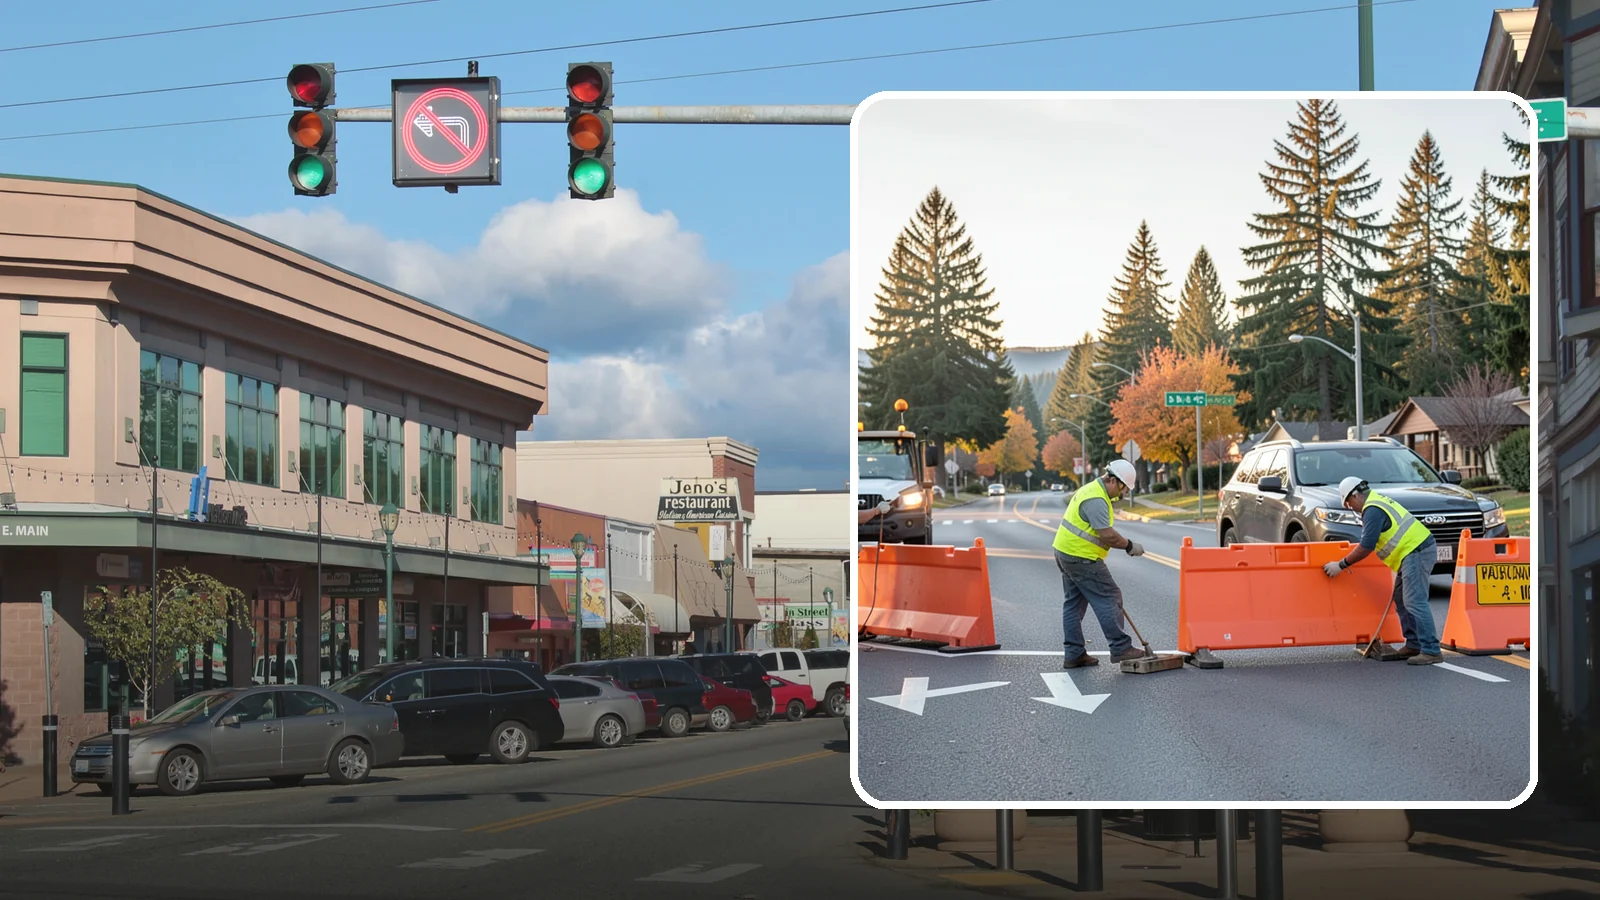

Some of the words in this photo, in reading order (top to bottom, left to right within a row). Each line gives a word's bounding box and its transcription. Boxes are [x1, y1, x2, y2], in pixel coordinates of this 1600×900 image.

[670, 480, 728, 494] Jeno's
[665, 496, 731, 509] restaurant
[659, 510, 681, 519] Italian
[686, 510, 714, 519] American
[715, 509, 737, 519] Cuisine
[2, 525, 13, 536] E.
[15, 525, 49, 536] MAIN
[797, 607, 829, 617] Street
